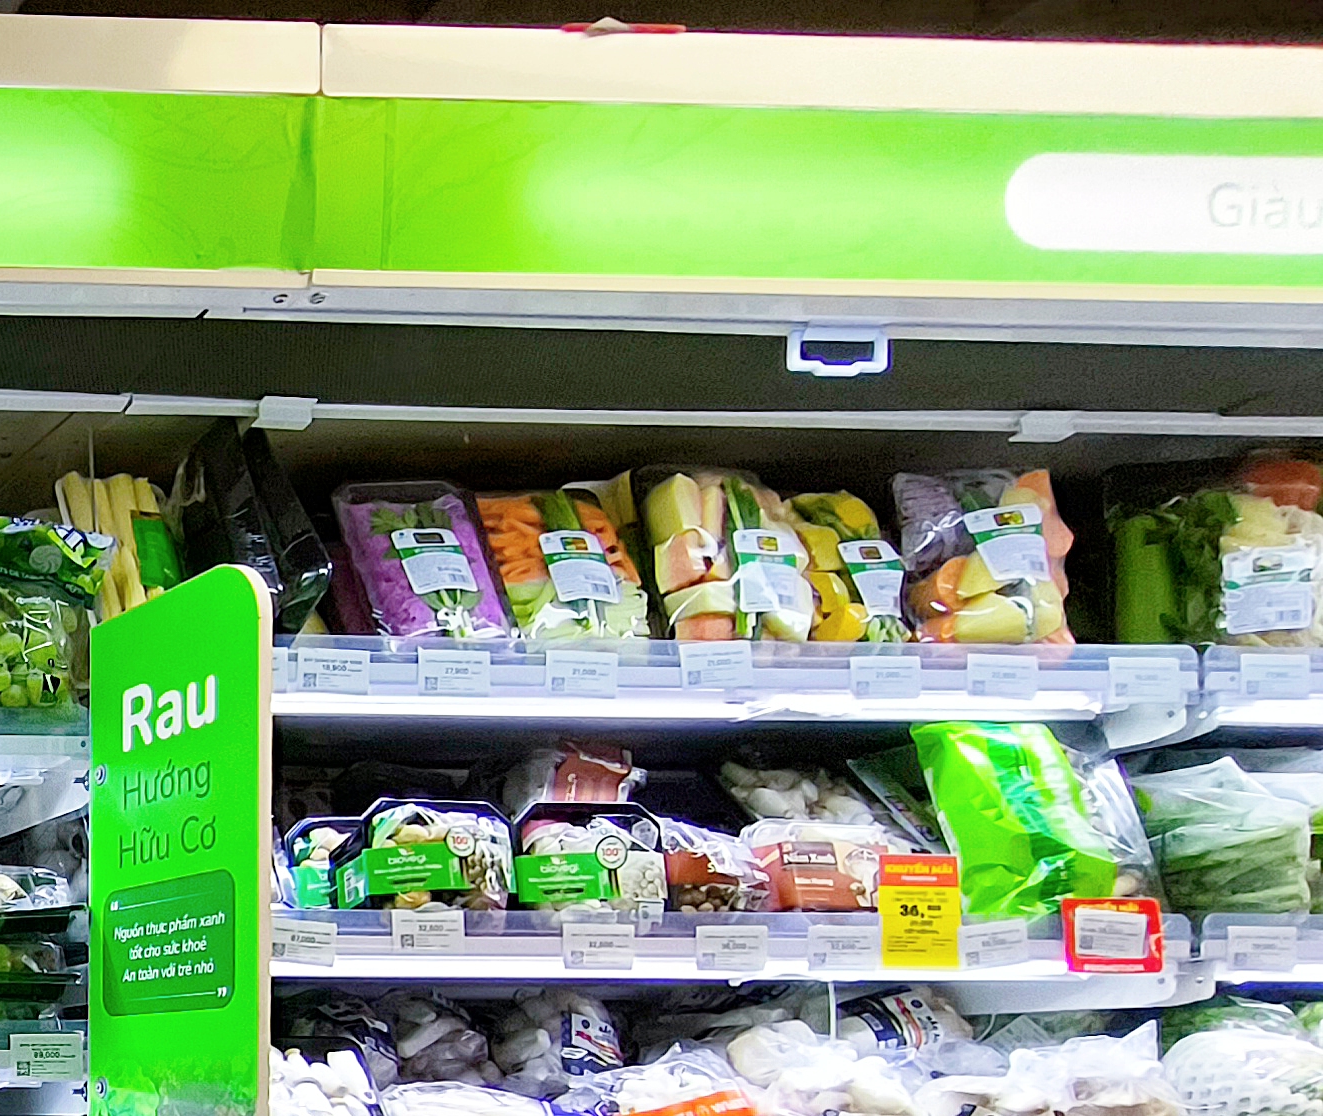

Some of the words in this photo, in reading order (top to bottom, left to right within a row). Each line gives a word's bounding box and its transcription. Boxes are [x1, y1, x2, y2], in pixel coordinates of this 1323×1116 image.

[122, 674, 219, 753] Rau
[123, 758, 212, 811] Hướng
[118, 825, 172, 869] Hữu
[180, 814, 218, 855] Cơ
[199, 911, 225, 927] xanh
[145, 943, 161, 958] cho
[122, 968, 136, 983] An
